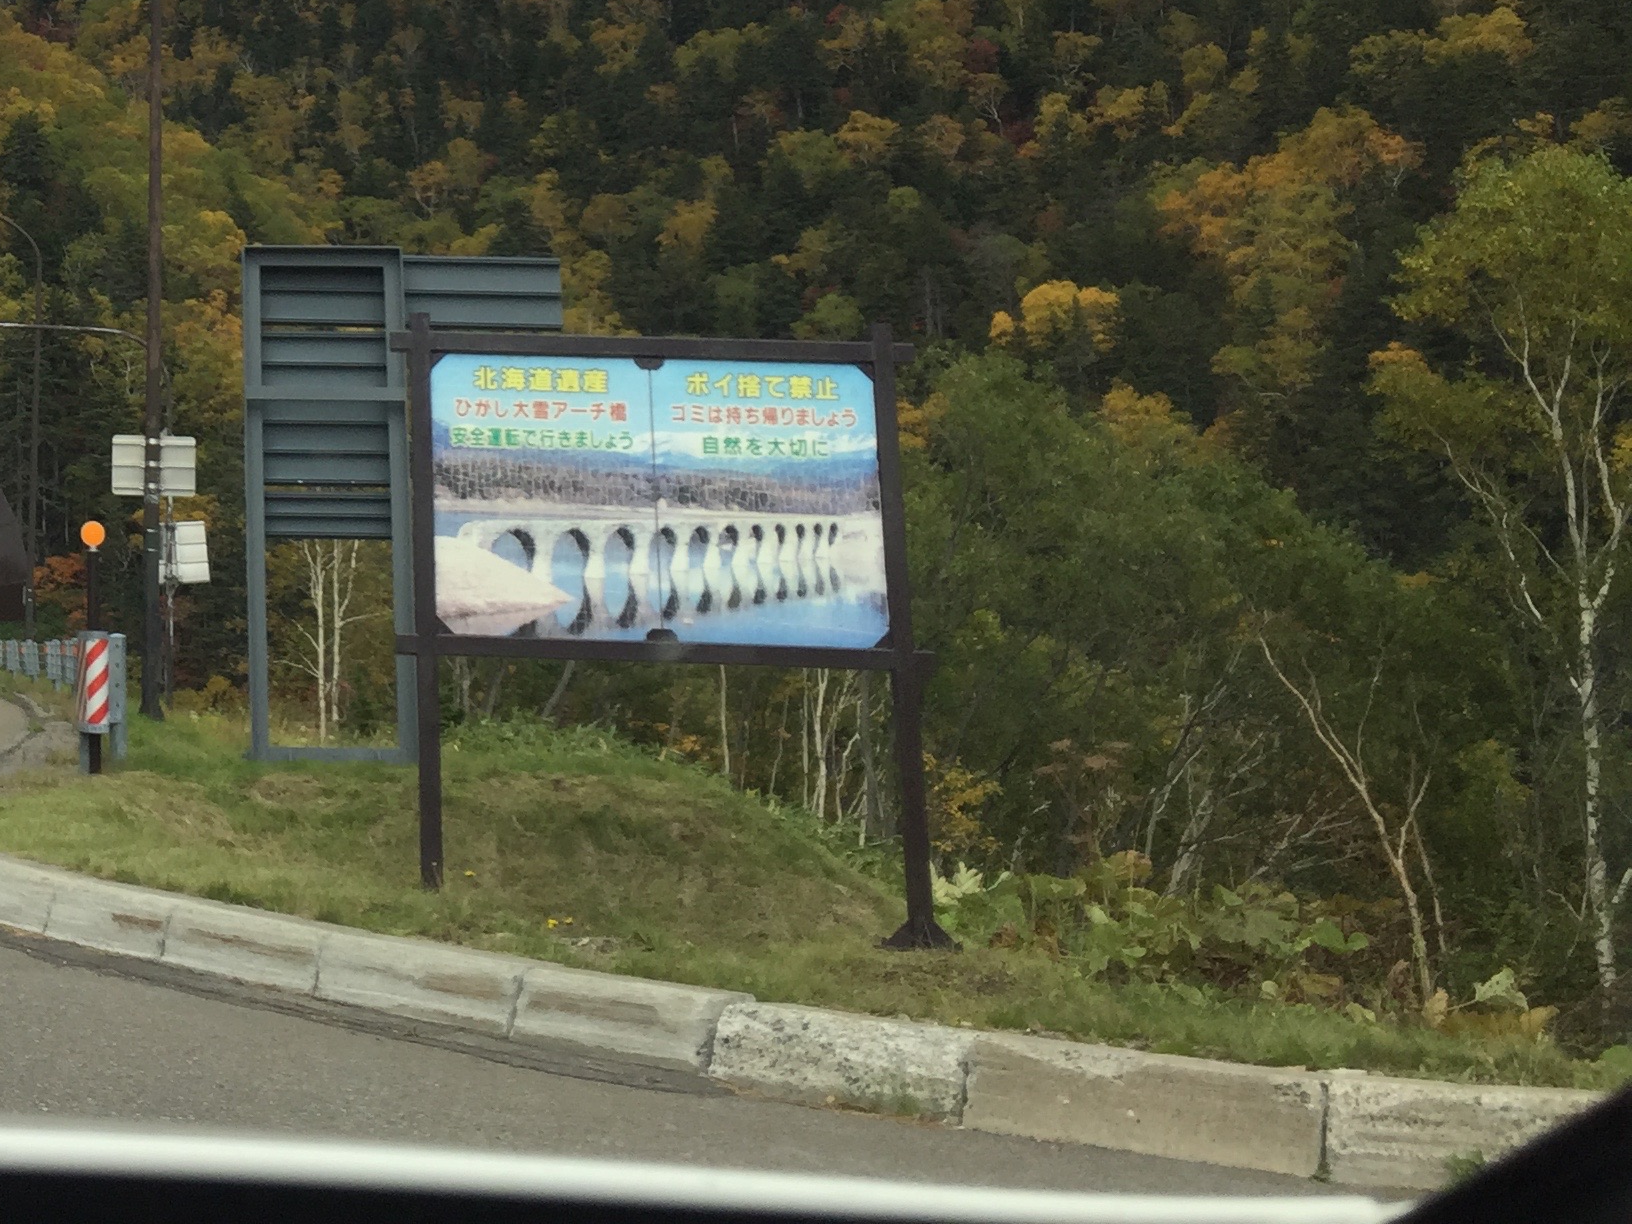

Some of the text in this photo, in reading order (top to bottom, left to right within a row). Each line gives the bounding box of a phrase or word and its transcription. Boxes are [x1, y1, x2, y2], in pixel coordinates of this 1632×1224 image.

[473, 366, 608, 393] 北海道遺産
[686, 372, 840, 400] ポイ捨て禁止
[455, 398, 627, 421] ひがし大雪アーチ橋
[672, 405, 857, 427] ゴミは持ち帰りましょう
[452, 427, 633, 449] 安全運転で行きましょう
[702, 436, 828, 456] 自然を大切に
